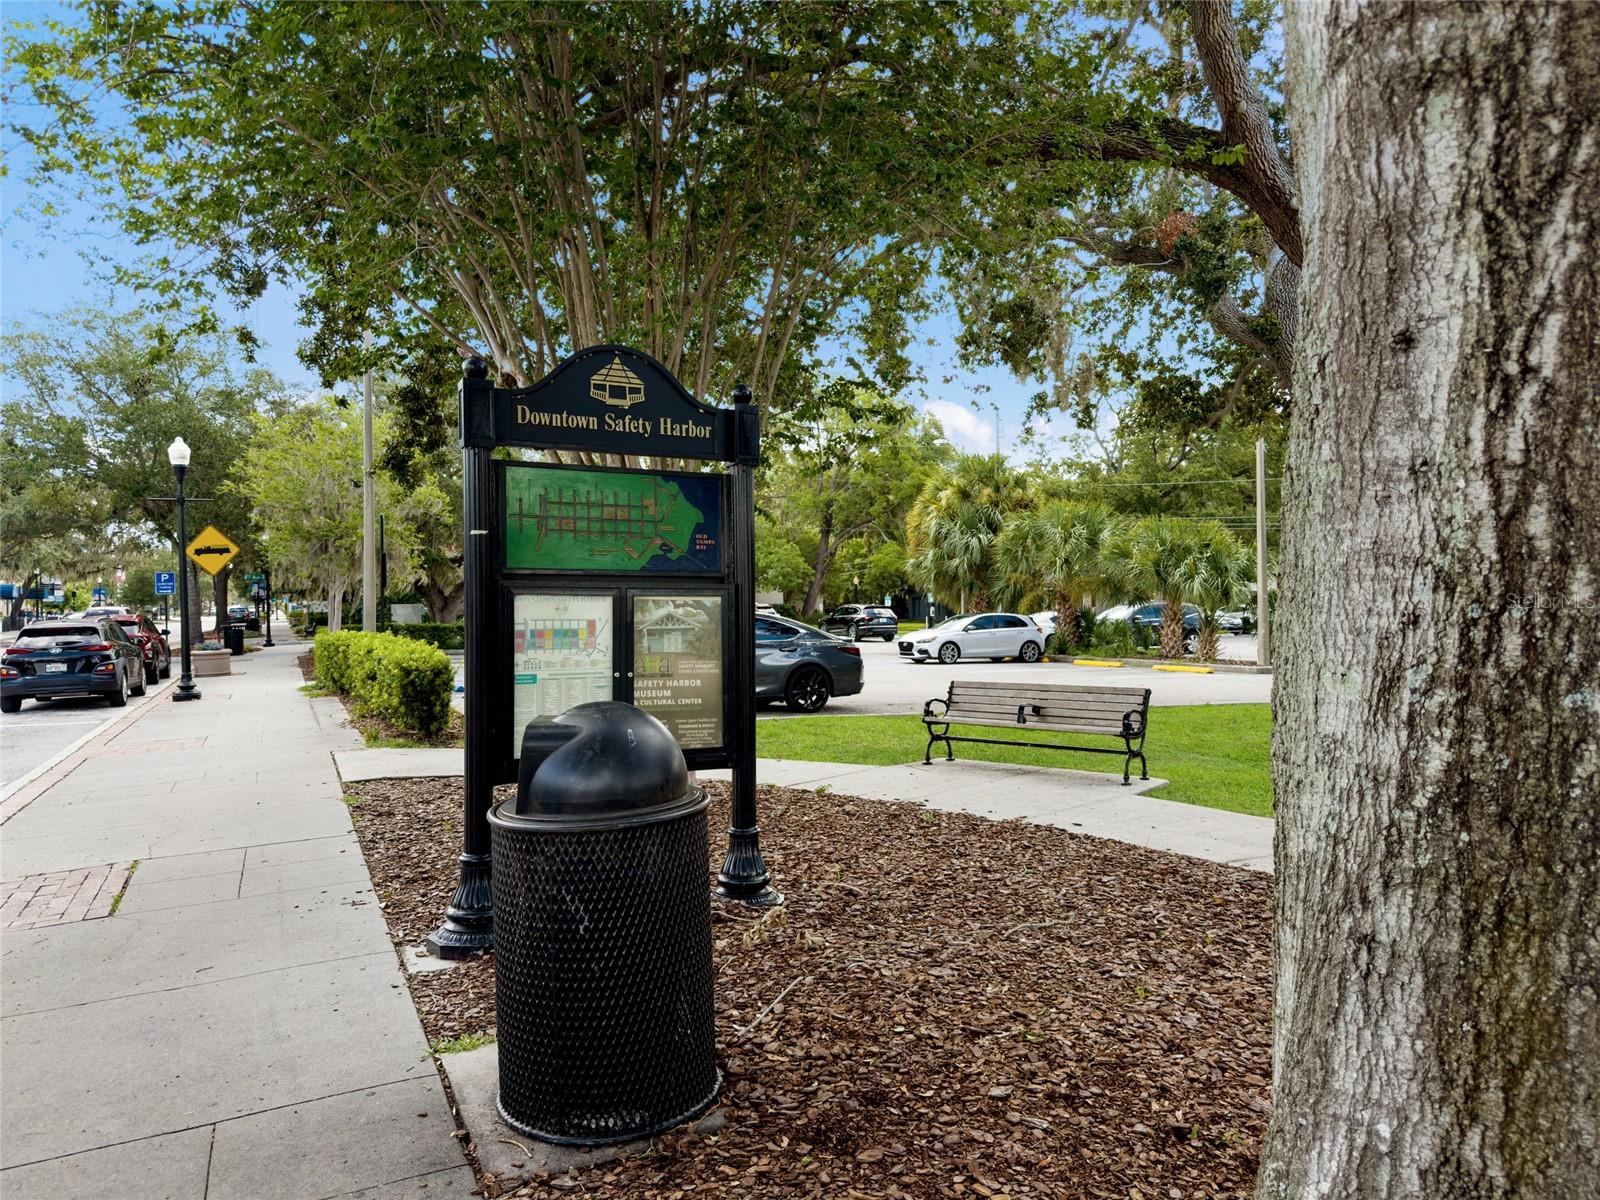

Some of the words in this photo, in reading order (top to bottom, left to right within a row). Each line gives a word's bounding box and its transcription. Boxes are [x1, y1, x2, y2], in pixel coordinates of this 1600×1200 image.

[516, 404, 598, 430] Downtown
[604, 412, 652, 437] Safety
[659, 417, 712, 439] Harbor
[161, 574, 169, 582] P
[666, 679, 702, 687] HARBOR
[634, 689, 672, 698] MUSEUM
